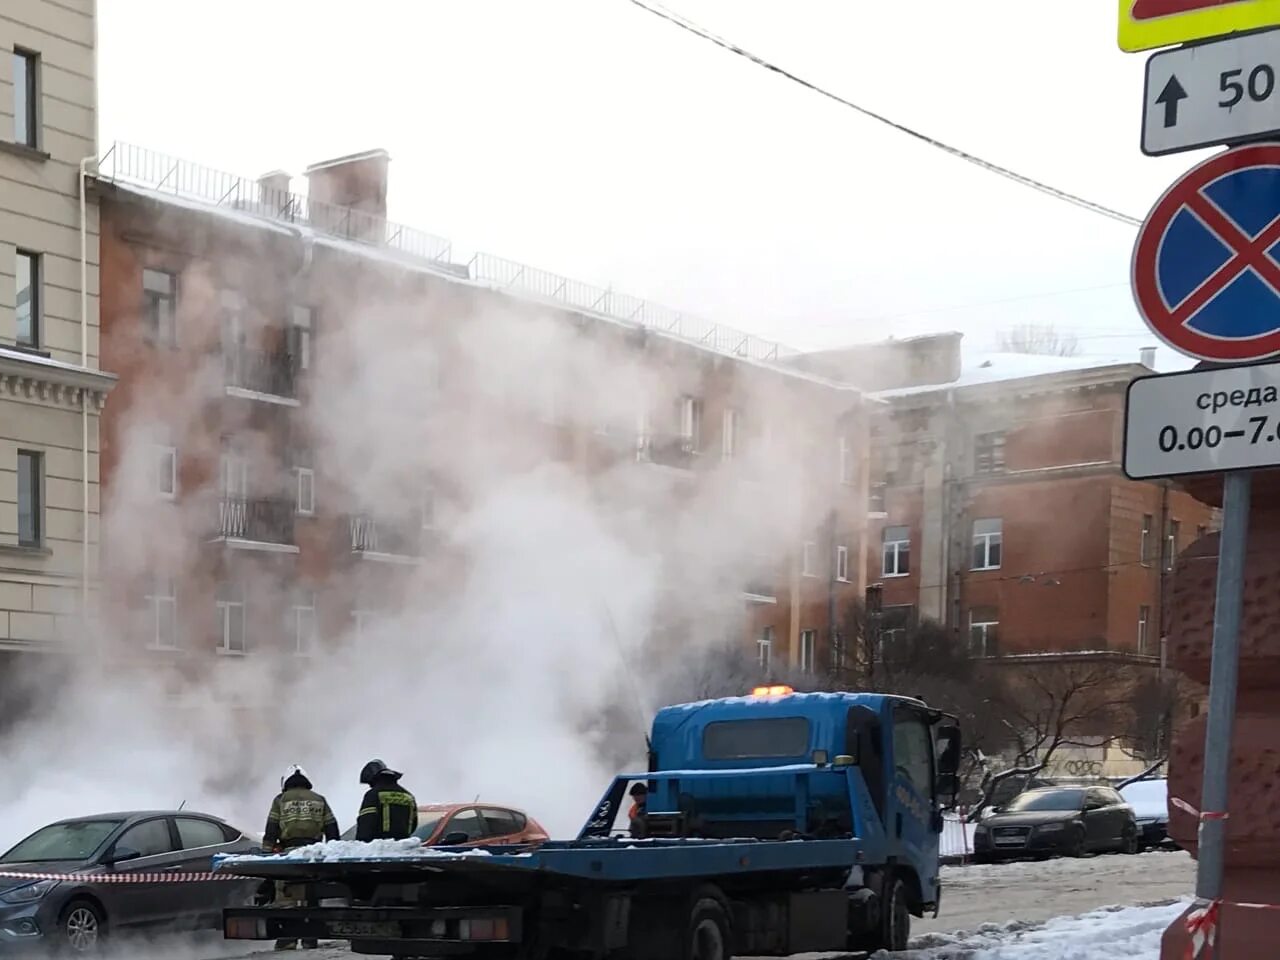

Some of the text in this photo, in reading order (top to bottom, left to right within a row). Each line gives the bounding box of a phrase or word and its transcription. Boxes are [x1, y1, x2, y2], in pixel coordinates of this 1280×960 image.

[1218, 63, 1275, 108] 50
[1196, 385, 1278, 414] среда
[1158, 415, 1280, 453] 0.00–7.
